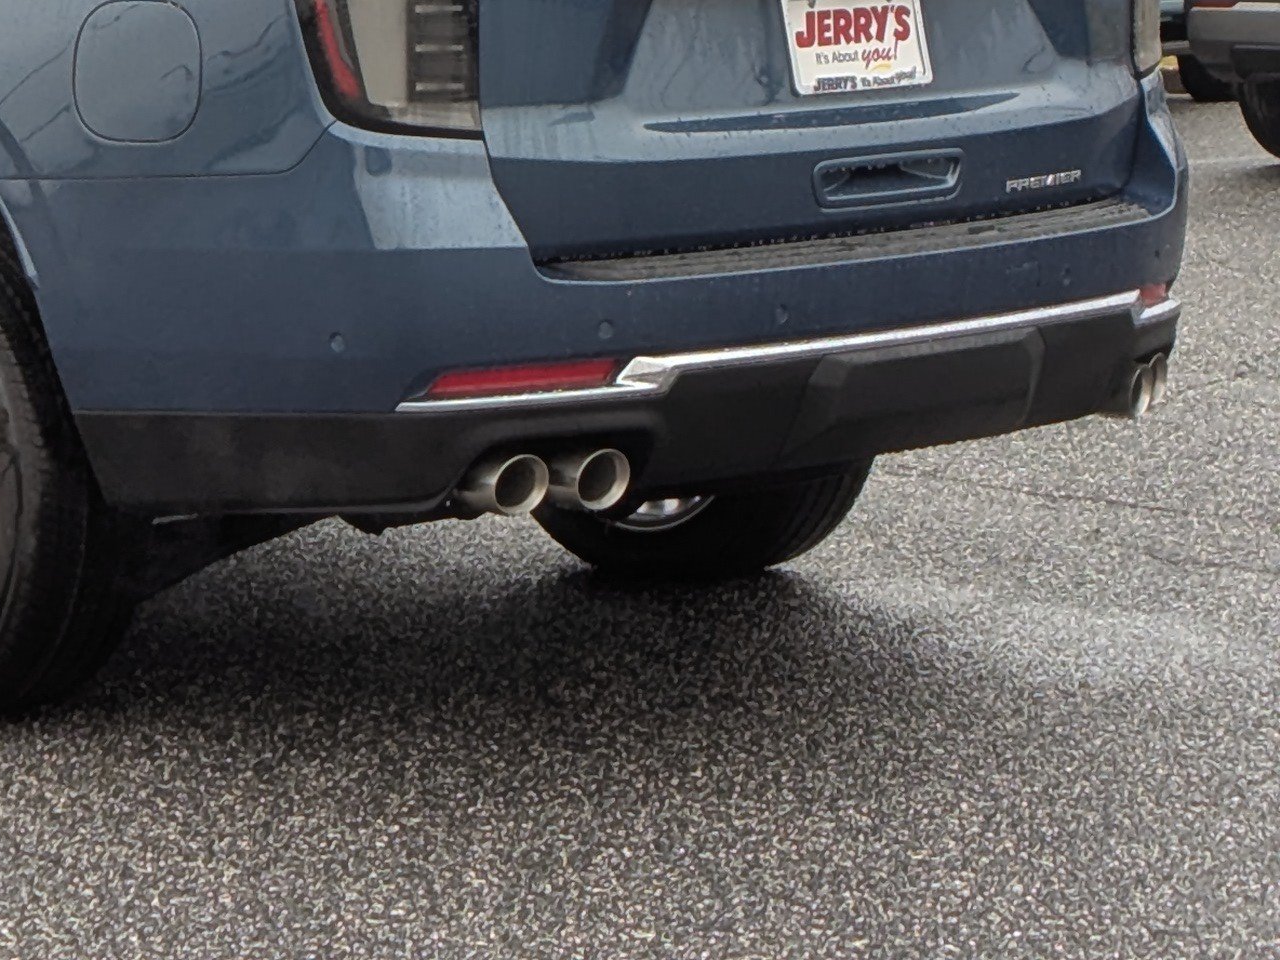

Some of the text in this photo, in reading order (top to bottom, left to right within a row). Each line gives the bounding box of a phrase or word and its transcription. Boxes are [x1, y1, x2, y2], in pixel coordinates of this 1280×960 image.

[795, 4, 912, 49] JERRY'S
[816, 40, 899, 70] It's About you!
